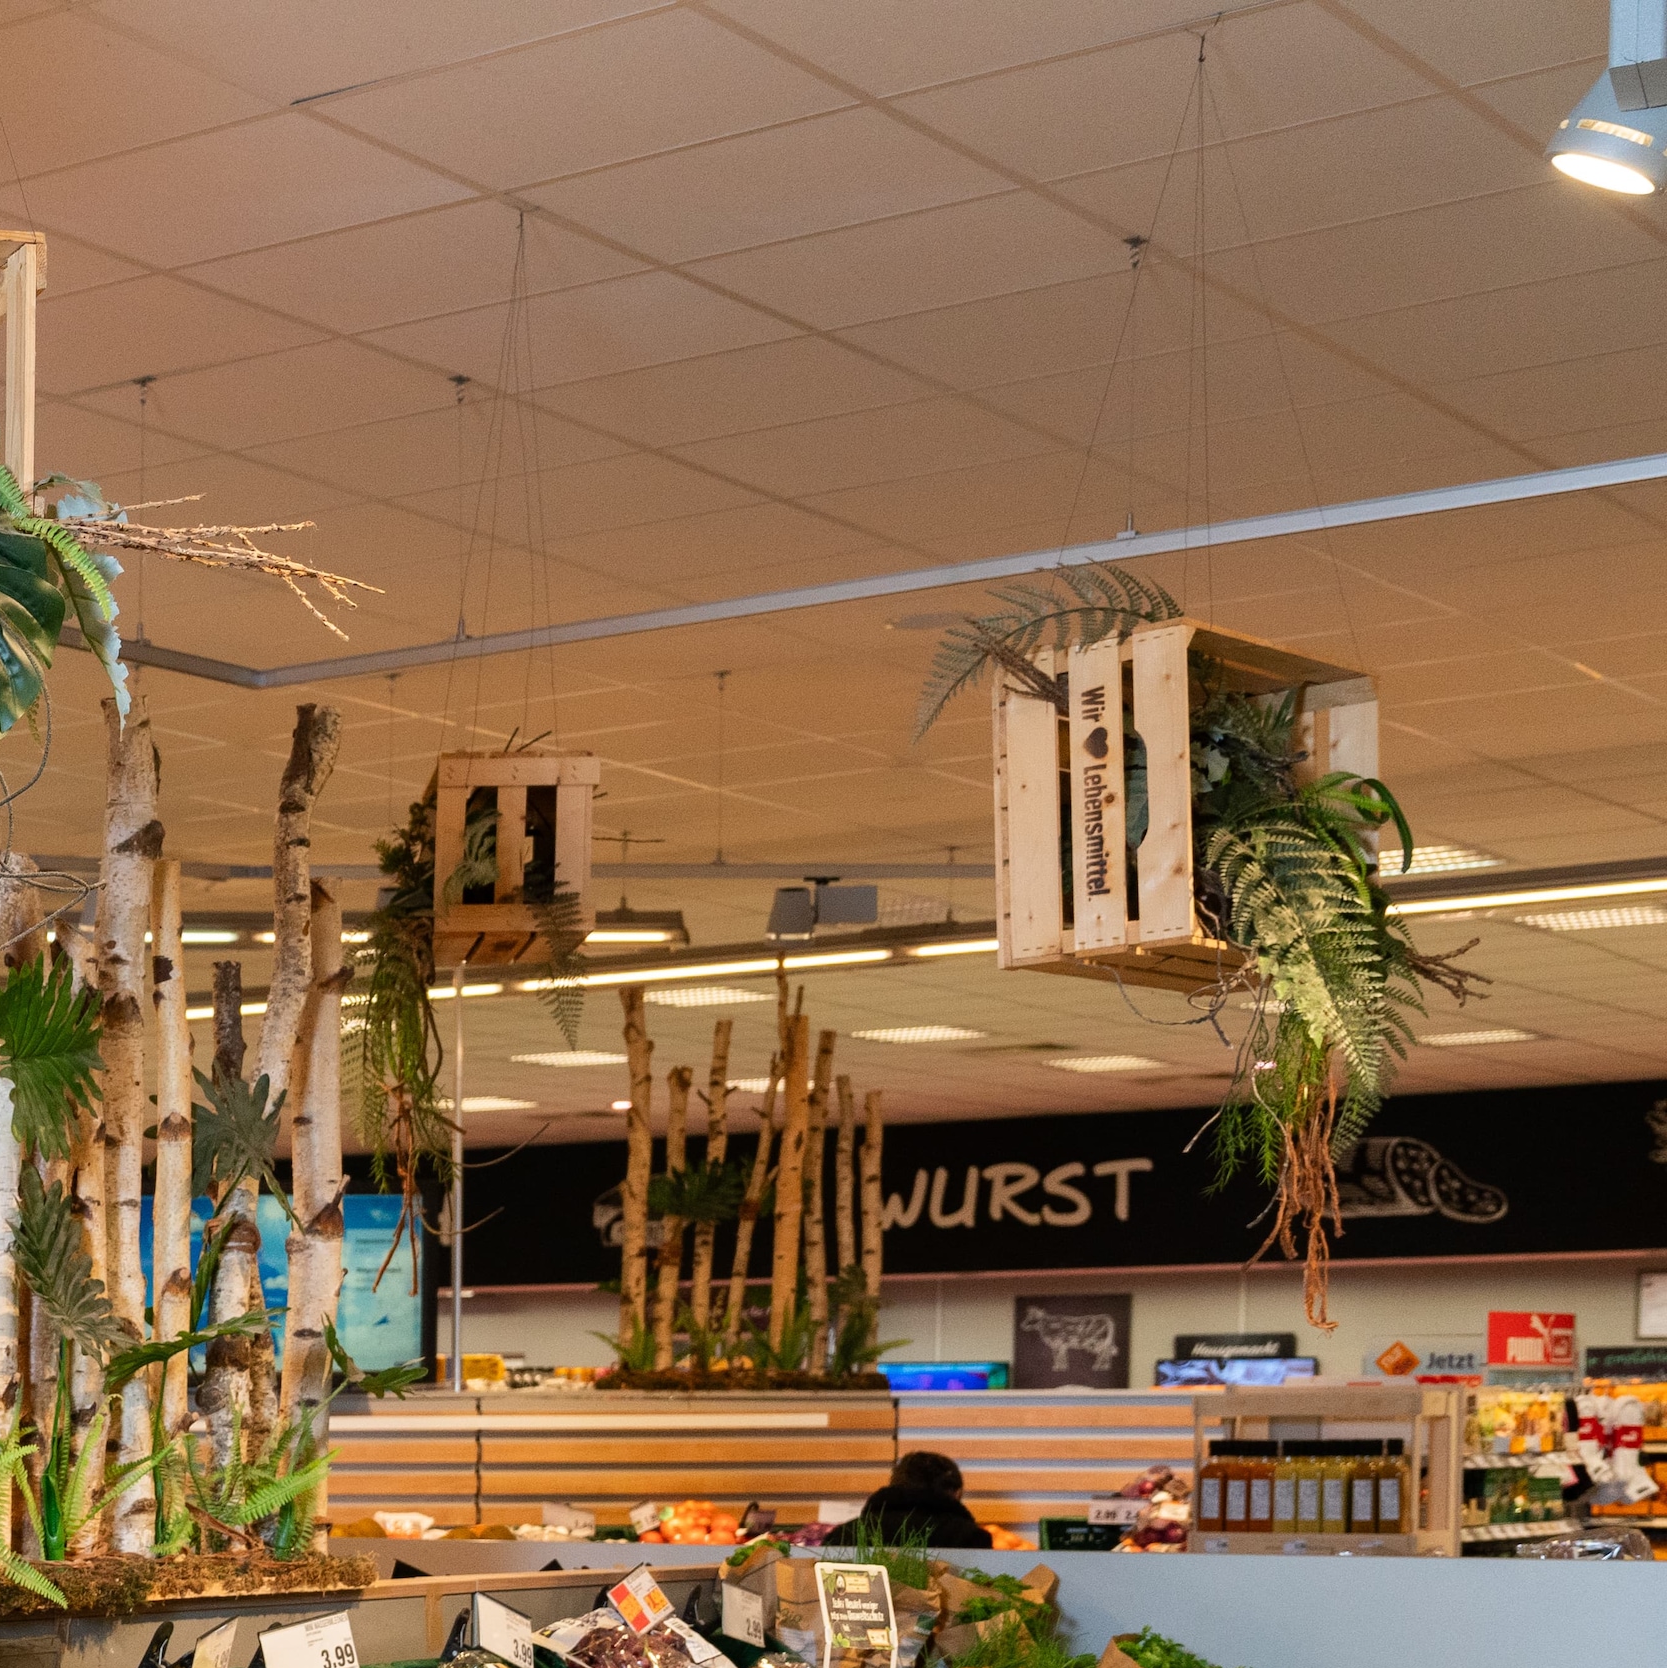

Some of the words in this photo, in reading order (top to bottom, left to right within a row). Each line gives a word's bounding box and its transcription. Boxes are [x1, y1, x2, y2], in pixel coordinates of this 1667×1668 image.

[1081, 685, 1105, 723] Wir
[1083, 763, 1111, 902] Lebensmittel.
[1427, 1351, 1475, 1370] Jetzt
[512, 1638, 533, 1667] 3.99
